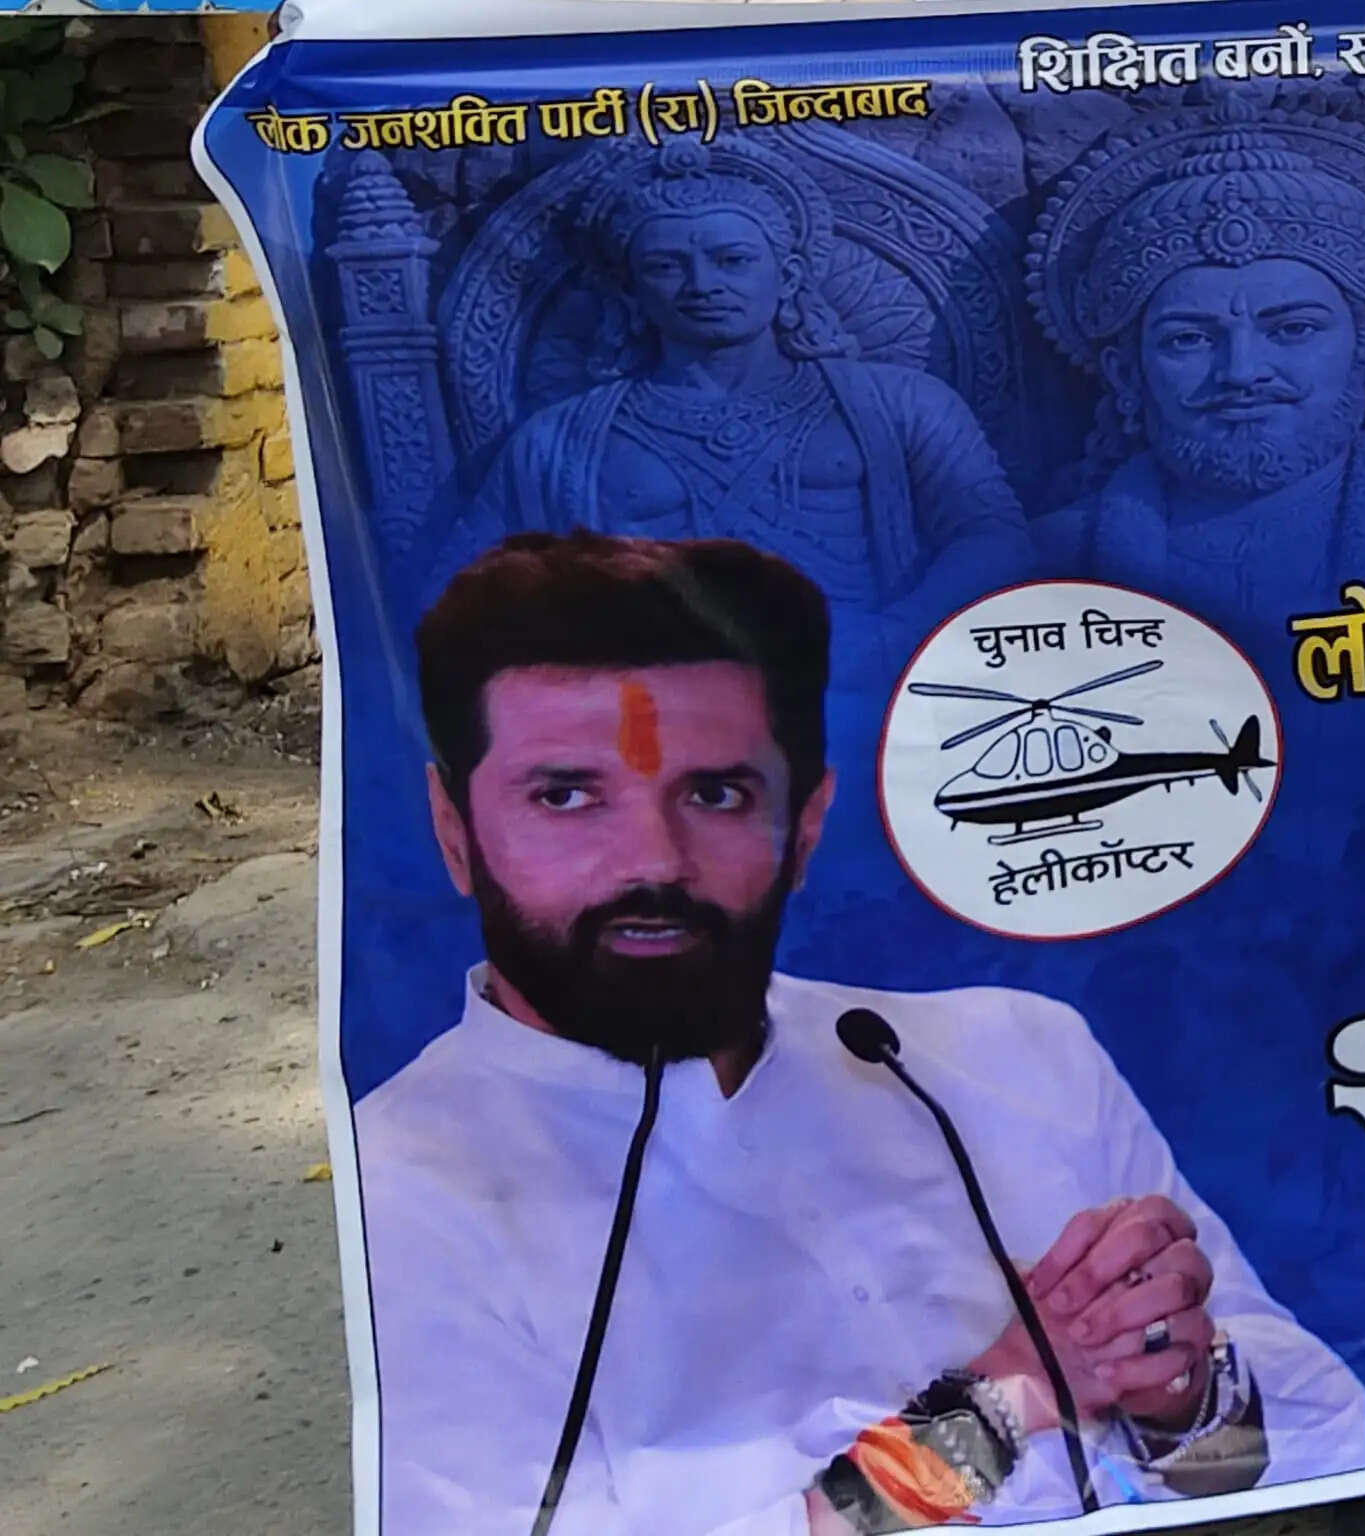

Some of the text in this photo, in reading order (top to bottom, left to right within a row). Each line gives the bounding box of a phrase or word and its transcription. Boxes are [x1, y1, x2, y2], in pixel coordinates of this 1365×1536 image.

[1018, 32, 1198, 93] शिक्षित
[249, 78, 931, 152] लोक जनशक्ति पार्टी (रा) जिन्दाबाद
[970, 608, 1165, 668] चुनाव चिन्ह
[988, 838, 1195, 906] हेलीकॉप्टर
